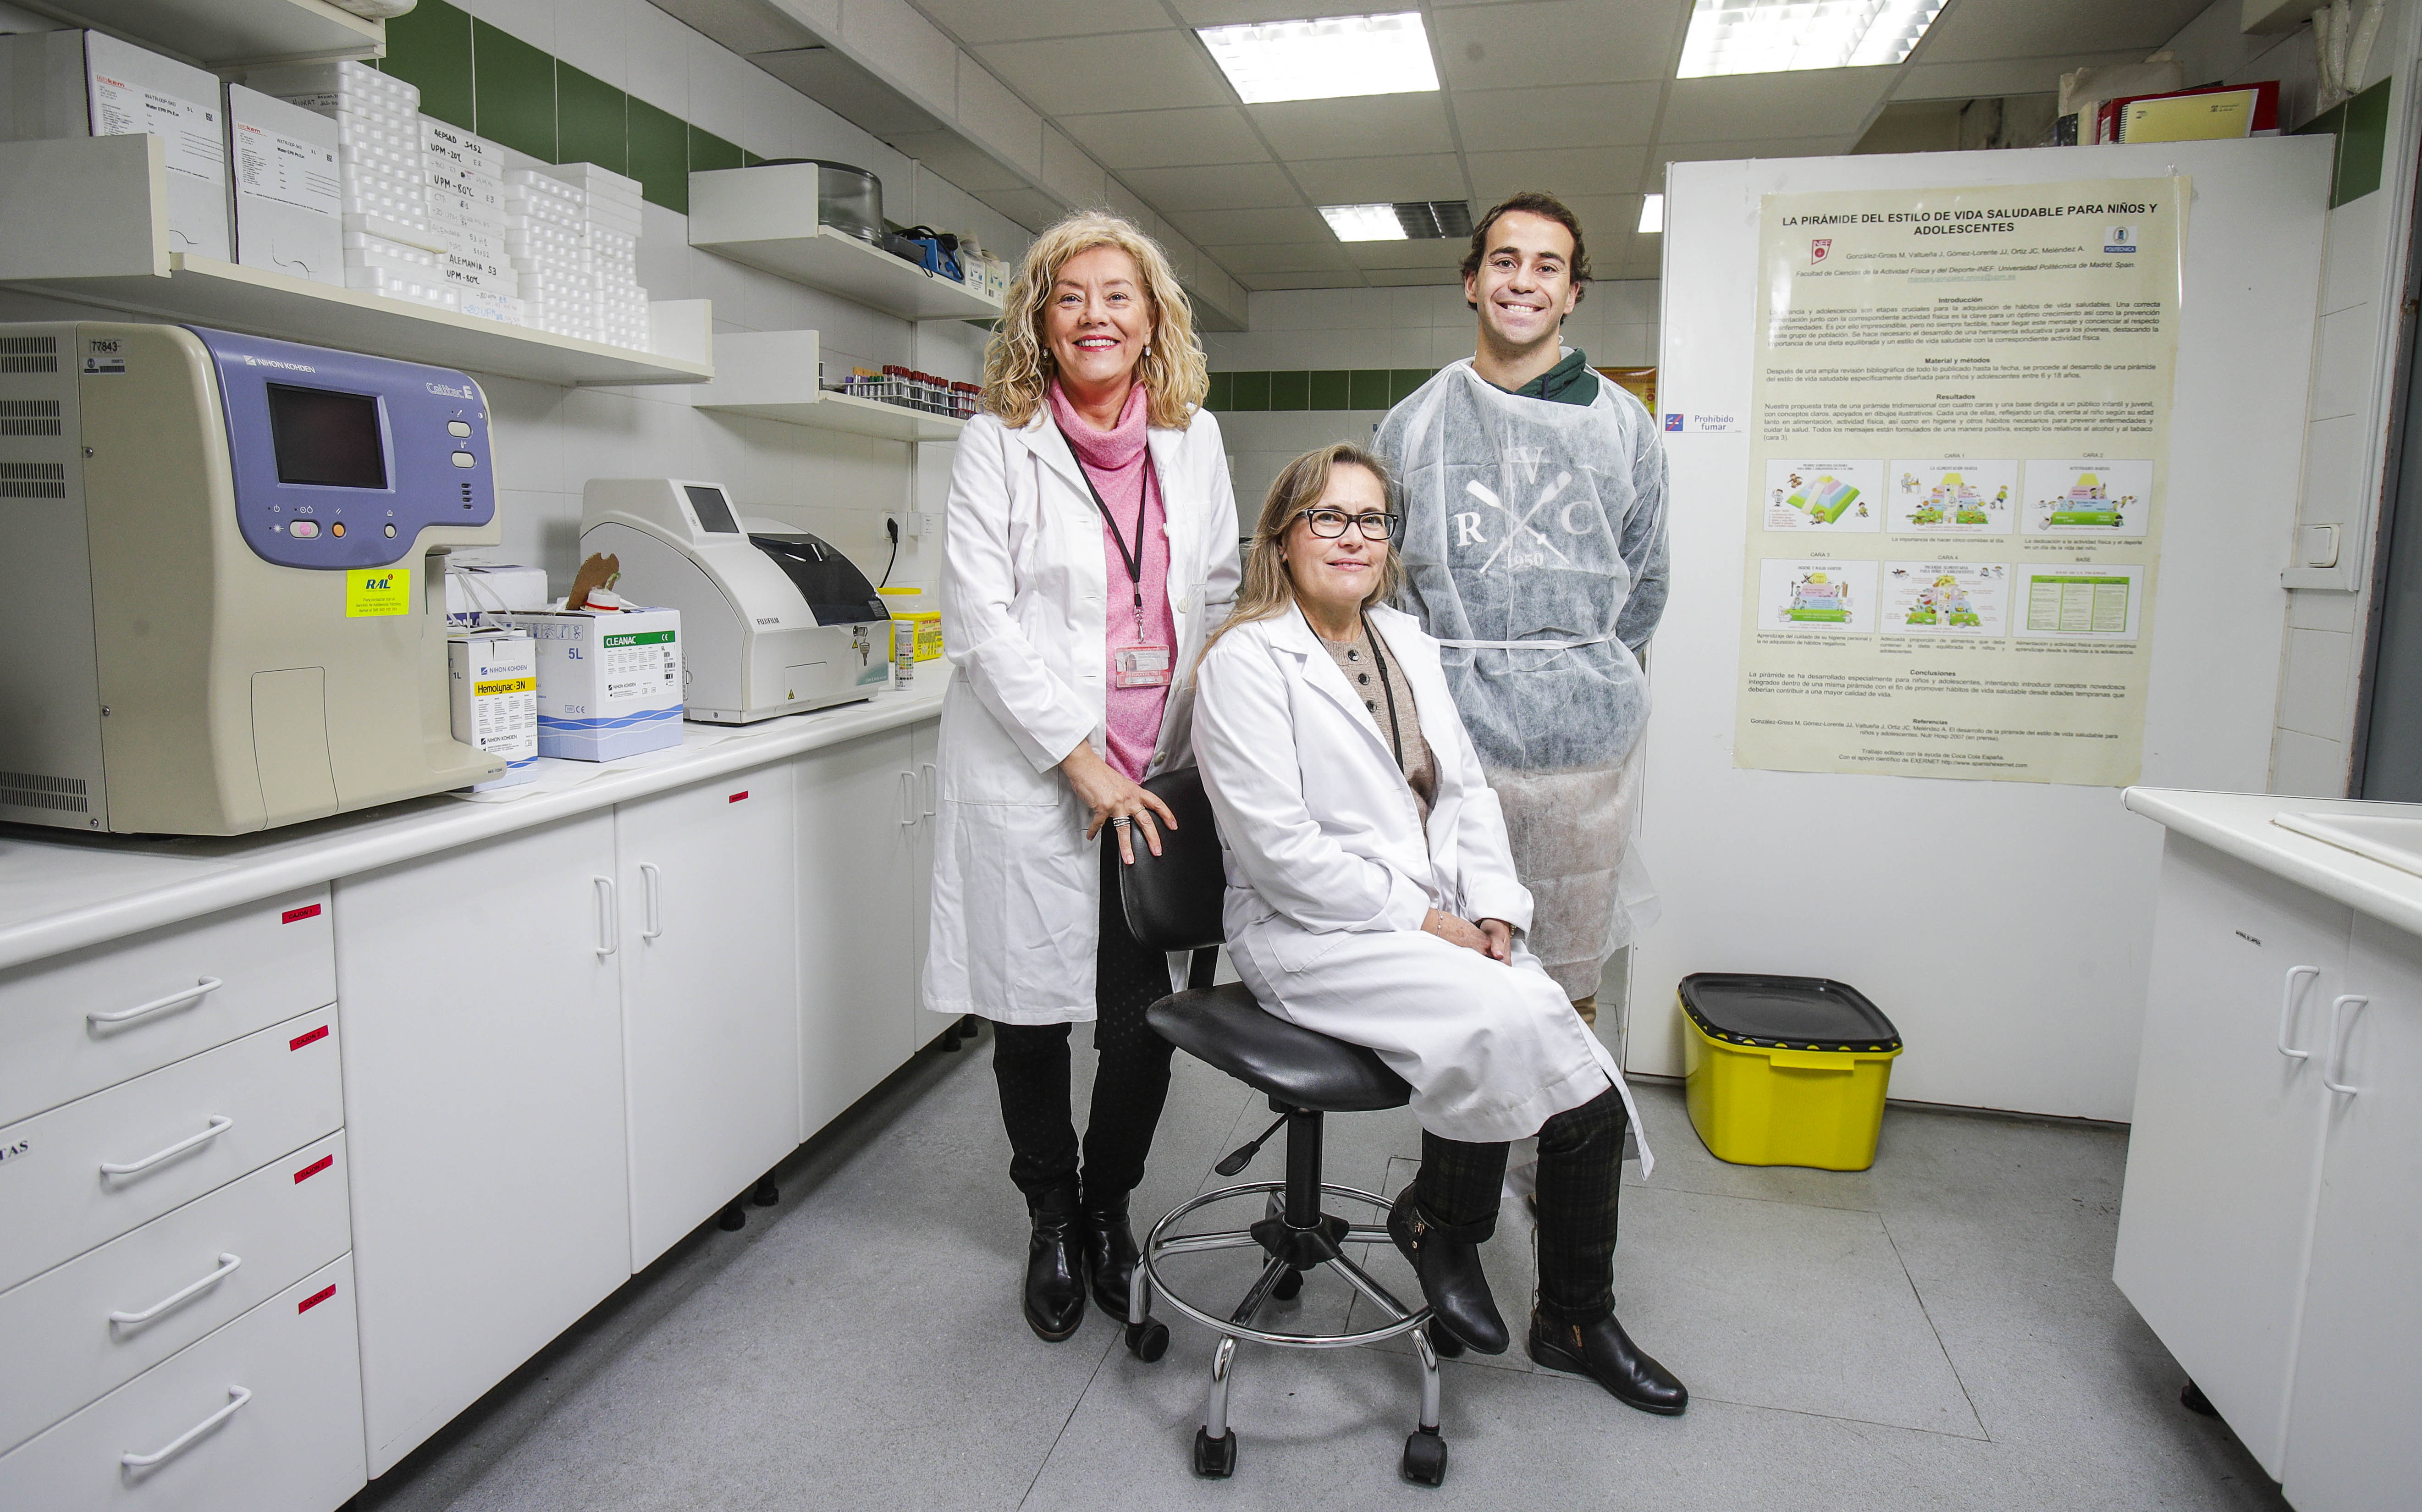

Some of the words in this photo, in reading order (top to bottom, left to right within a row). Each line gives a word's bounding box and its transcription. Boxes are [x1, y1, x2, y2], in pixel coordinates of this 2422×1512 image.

[431, 143, 446, 156] UPM
[434, 175, 451, 189] UPM
[1783, 217, 1797, 226] LA
[1802, 214, 1857, 225] PIRÁMIDE
[1862, 214, 1884, 223] DEL
[1888, 212, 1930, 222] ESTILO
[1934, 211, 1950, 221] DE
[1954, 210, 1983, 220] VIDA
[1987, 207, 2063, 219] SALUDABLE
[2068, 204, 2103, 215] PARA
[2108, 203, 2146, 214] NIÑOS
[2149, 204, 2157, 213] Y
[1914, 223, 2014, 235] ADOLESCENTES
[447, 269, 461, 281] UPM
[488, 265, 497, 276] S3
[92, 341, 118, 352] 77843
[258, 358, 285, 370] NIHON
[285, 363, 316, 374] KOHDEN
[426, 381, 464, 399] Celltac
[463, 385, 474, 400] E
[1694, 414, 1734, 423] Prohibido
[1454, 511, 1488, 547] R
[1561, 501, 1594, 535] C
[366, 579, 391, 590] RAL
[606, 636, 637, 646] CLEANAC
[568, 648, 584, 660] 5L
[289, 910, 309, 920] CAJON
[297, 1033, 316, 1045] CAJON
[301, 1164, 320, 1178] CAJON
[304, 1293, 324, 1308] CAJON
